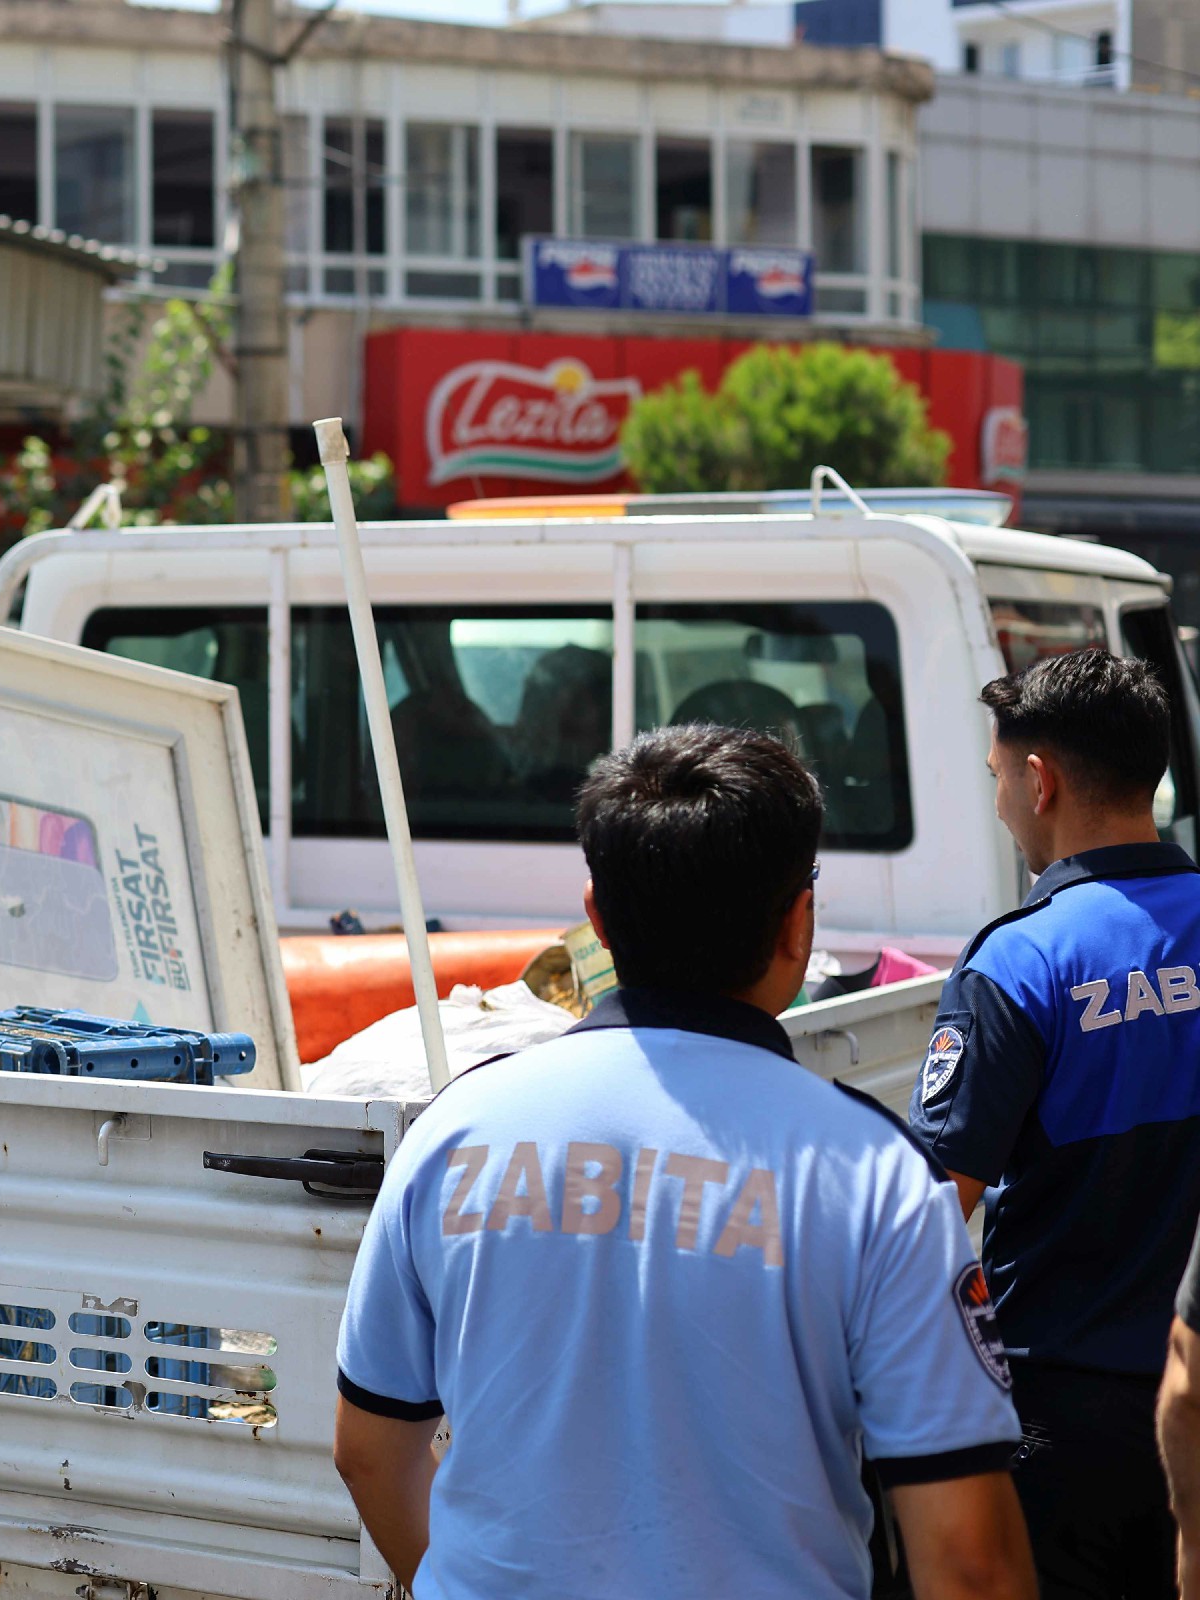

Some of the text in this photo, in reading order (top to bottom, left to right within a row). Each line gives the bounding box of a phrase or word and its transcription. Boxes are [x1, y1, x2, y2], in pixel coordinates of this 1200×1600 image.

[115, 848, 167, 985] FIRSAT
[133, 822, 184, 959] FIRSAT
[1070, 964, 1200, 1032] ZAB
[442, 1141, 784, 1267] ZABITA
